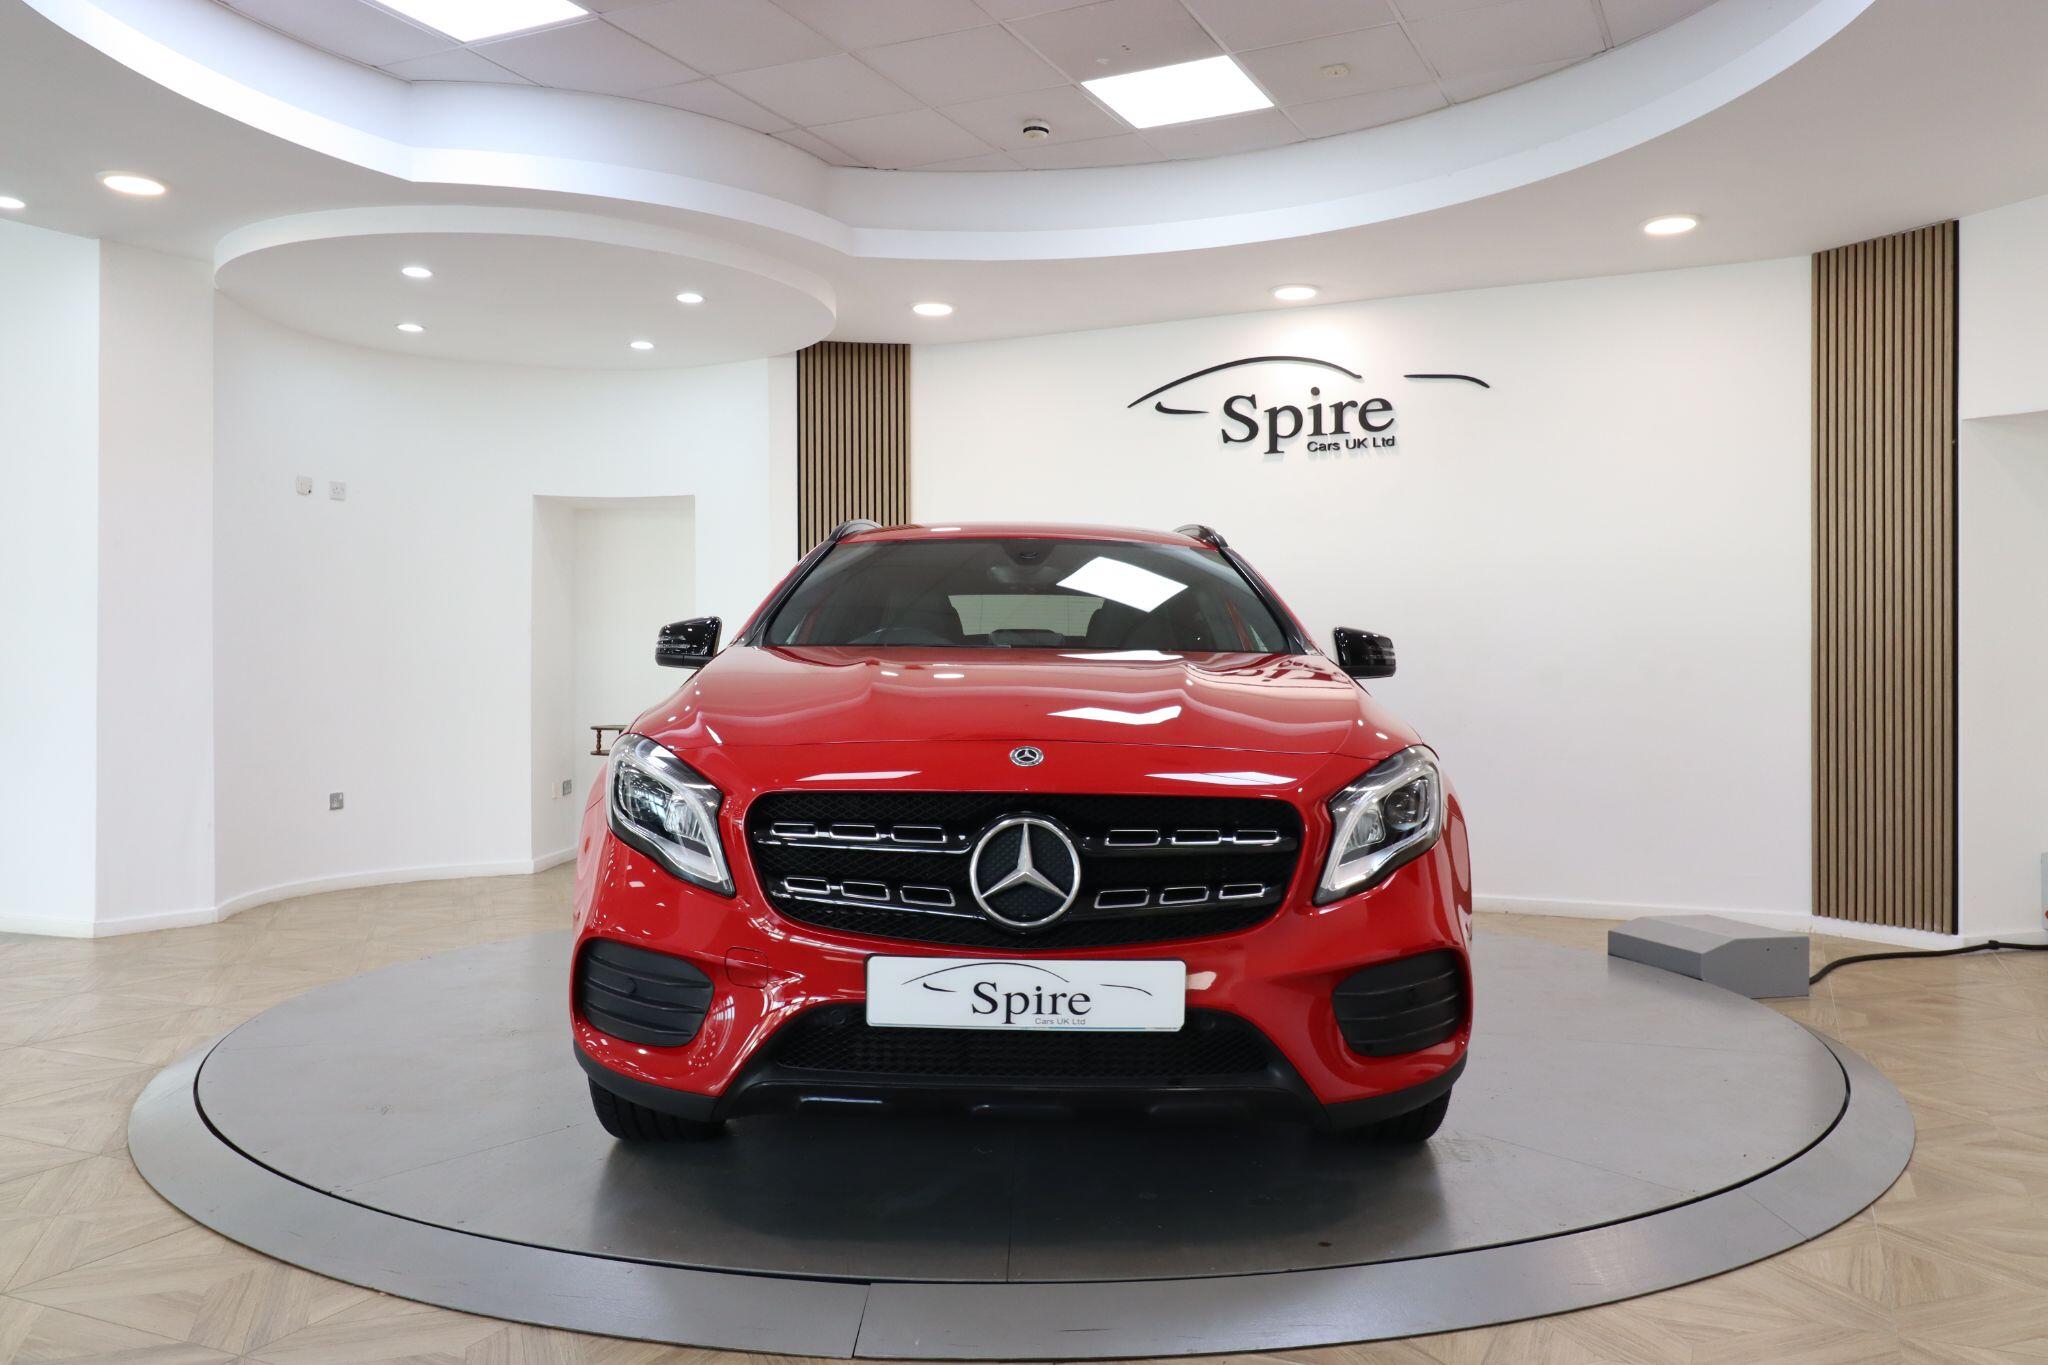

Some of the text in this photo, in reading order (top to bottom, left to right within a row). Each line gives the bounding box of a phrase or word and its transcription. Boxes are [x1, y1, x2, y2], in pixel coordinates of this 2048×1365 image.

[1221, 386, 1395, 455] Spire
[1306, 435, 1395, 453] Cars UK Ltd
[971, 981, 1092, 1025] Spire
[1034, 1017, 1086, 1025] Cars UK Ltd
